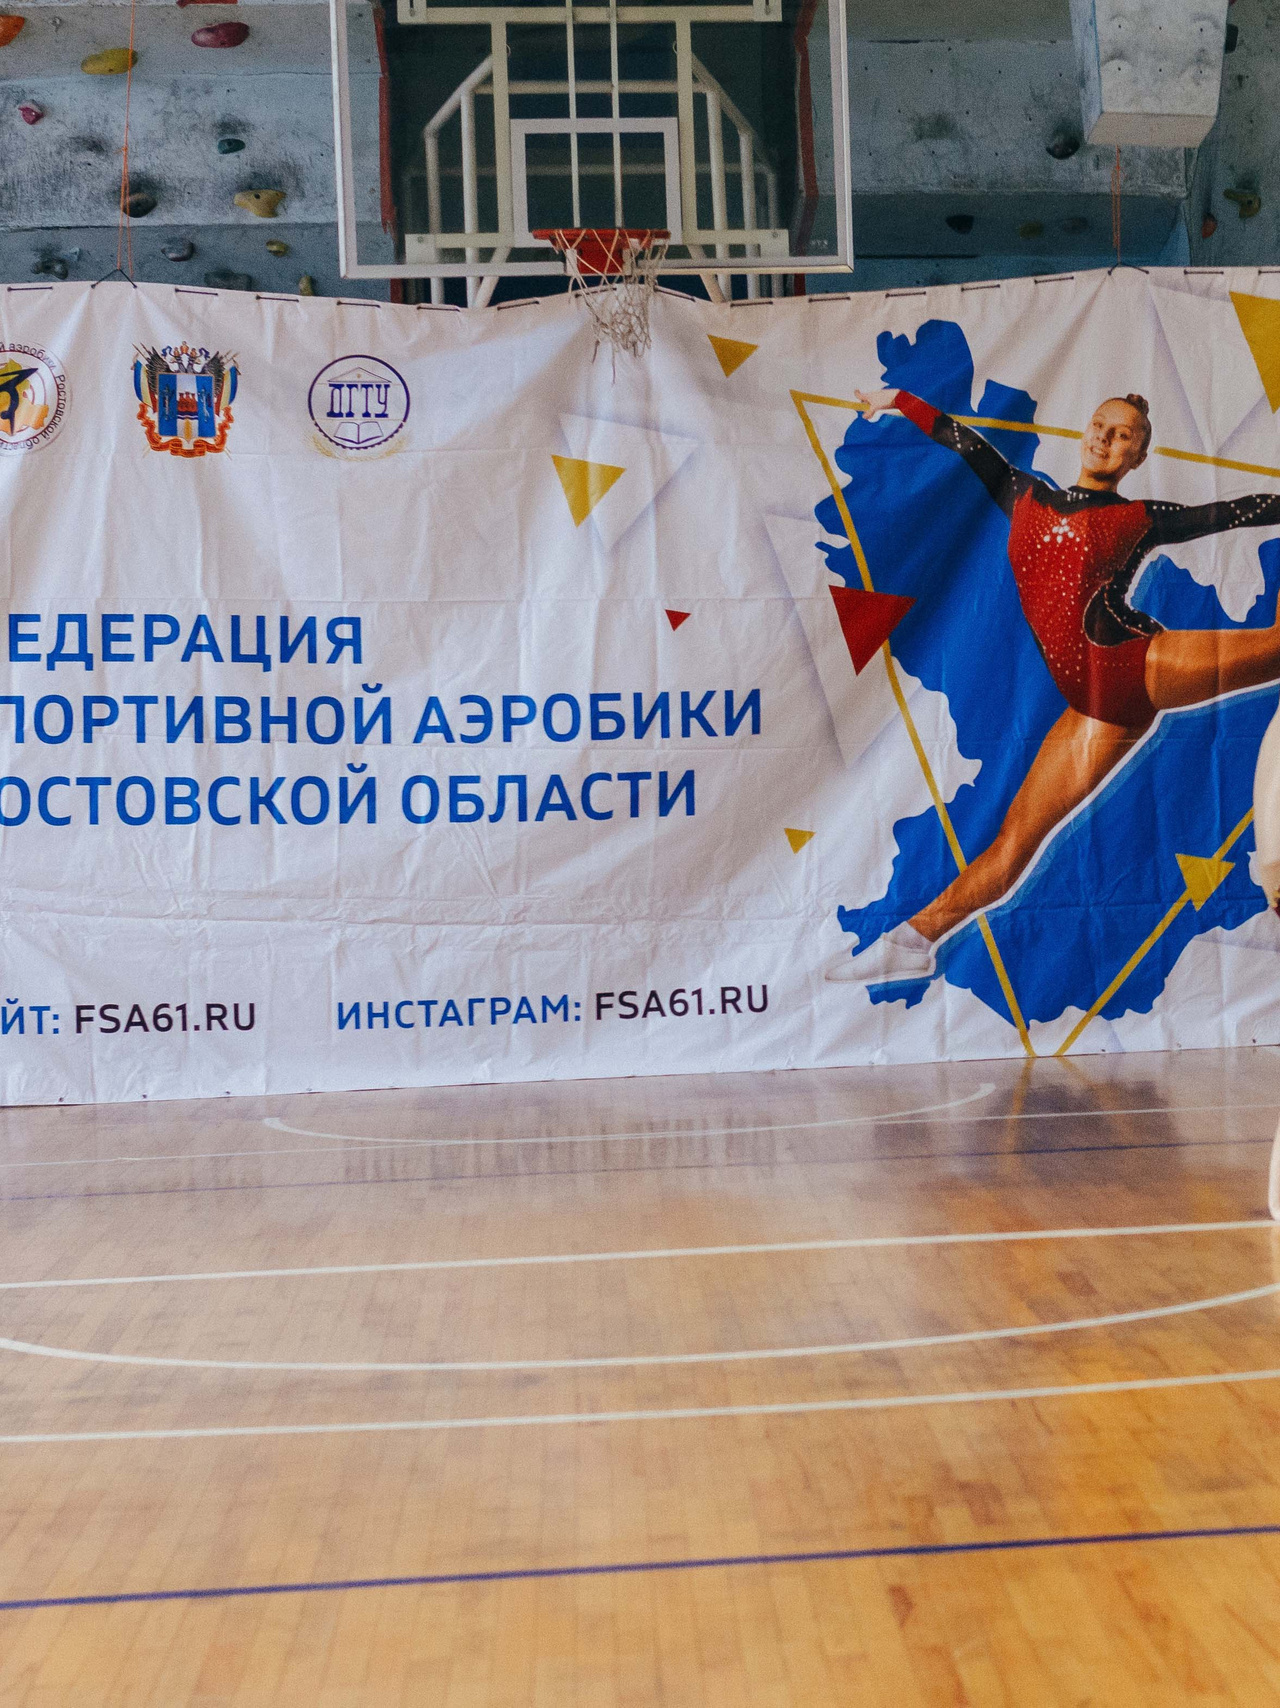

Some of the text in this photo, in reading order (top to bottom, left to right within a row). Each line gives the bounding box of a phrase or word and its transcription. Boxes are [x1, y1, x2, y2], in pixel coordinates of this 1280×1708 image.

[41, 374, 67, 441] Ростовской
[326, 383, 391, 418] ДГТУ
[8, 613, 362, 672] ЕДЕРАЦИЯ
[413, 688, 761, 745] АЭРОБИКИ
[0, 763, 696, 826] ОСТОВСКОЙ ОБЛАСТИ
[1, 998, 255, 1035] ЙТ: FSA61.RU
[337, 985, 768, 1030] ИНСТАГРАМ: FSA61.RU
